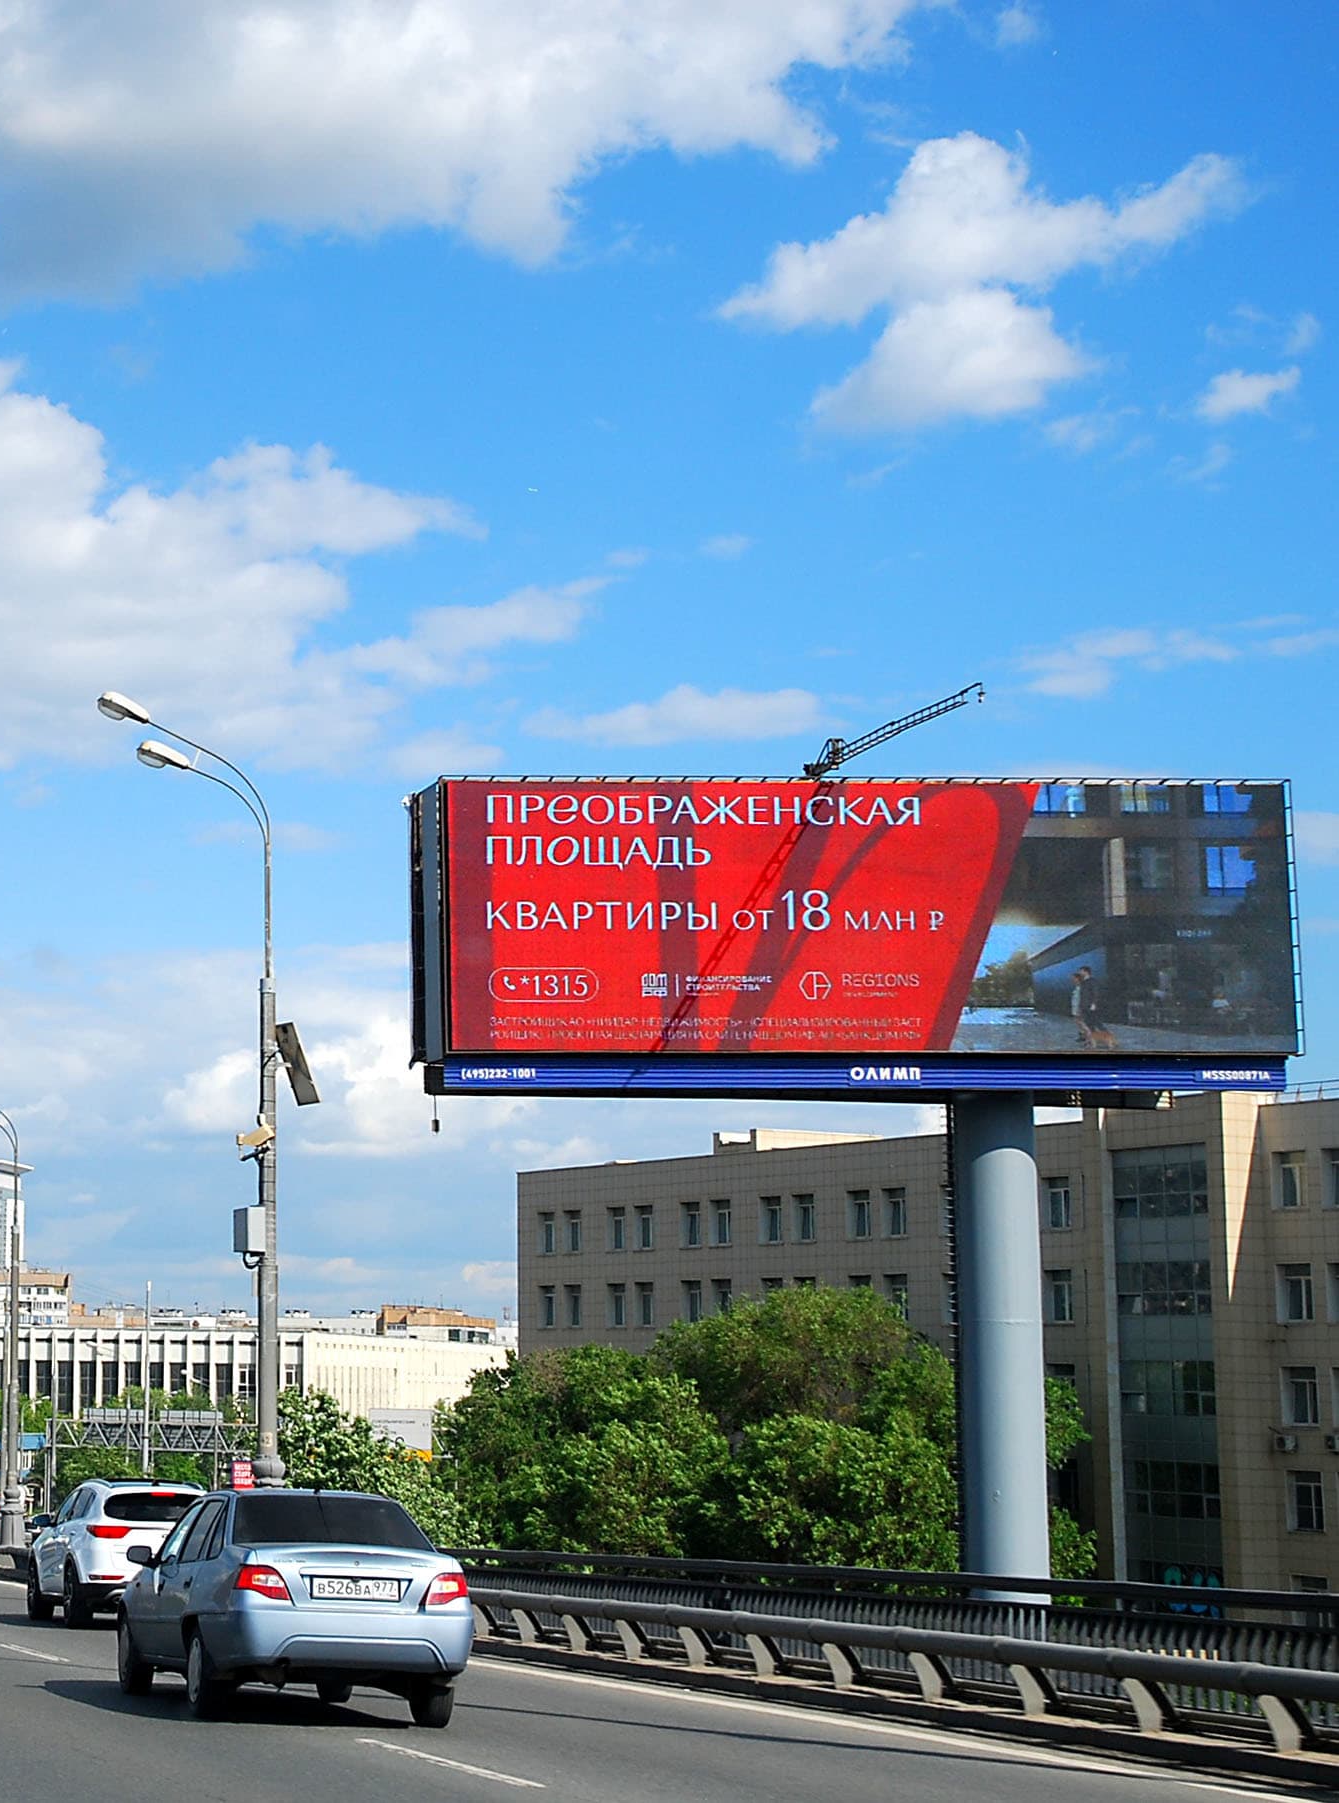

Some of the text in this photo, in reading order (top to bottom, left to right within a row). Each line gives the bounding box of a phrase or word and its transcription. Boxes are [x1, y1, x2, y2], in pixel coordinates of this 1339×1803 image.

[486, 794, 921, 826] ПРЕОБРАЖЕНСКАЯ
[486, 835, 712, 871] ПЛОЩАДЬ
[486, 901, 717, 931] КВАРТИРЫ
[781, 889, 831, 931] 18
[842, 973, 920, 987] REGIONS
[461, 1067, 536, 1080] (495)232-1001
[850, 1066, 921, 1080] ОЛИМП
